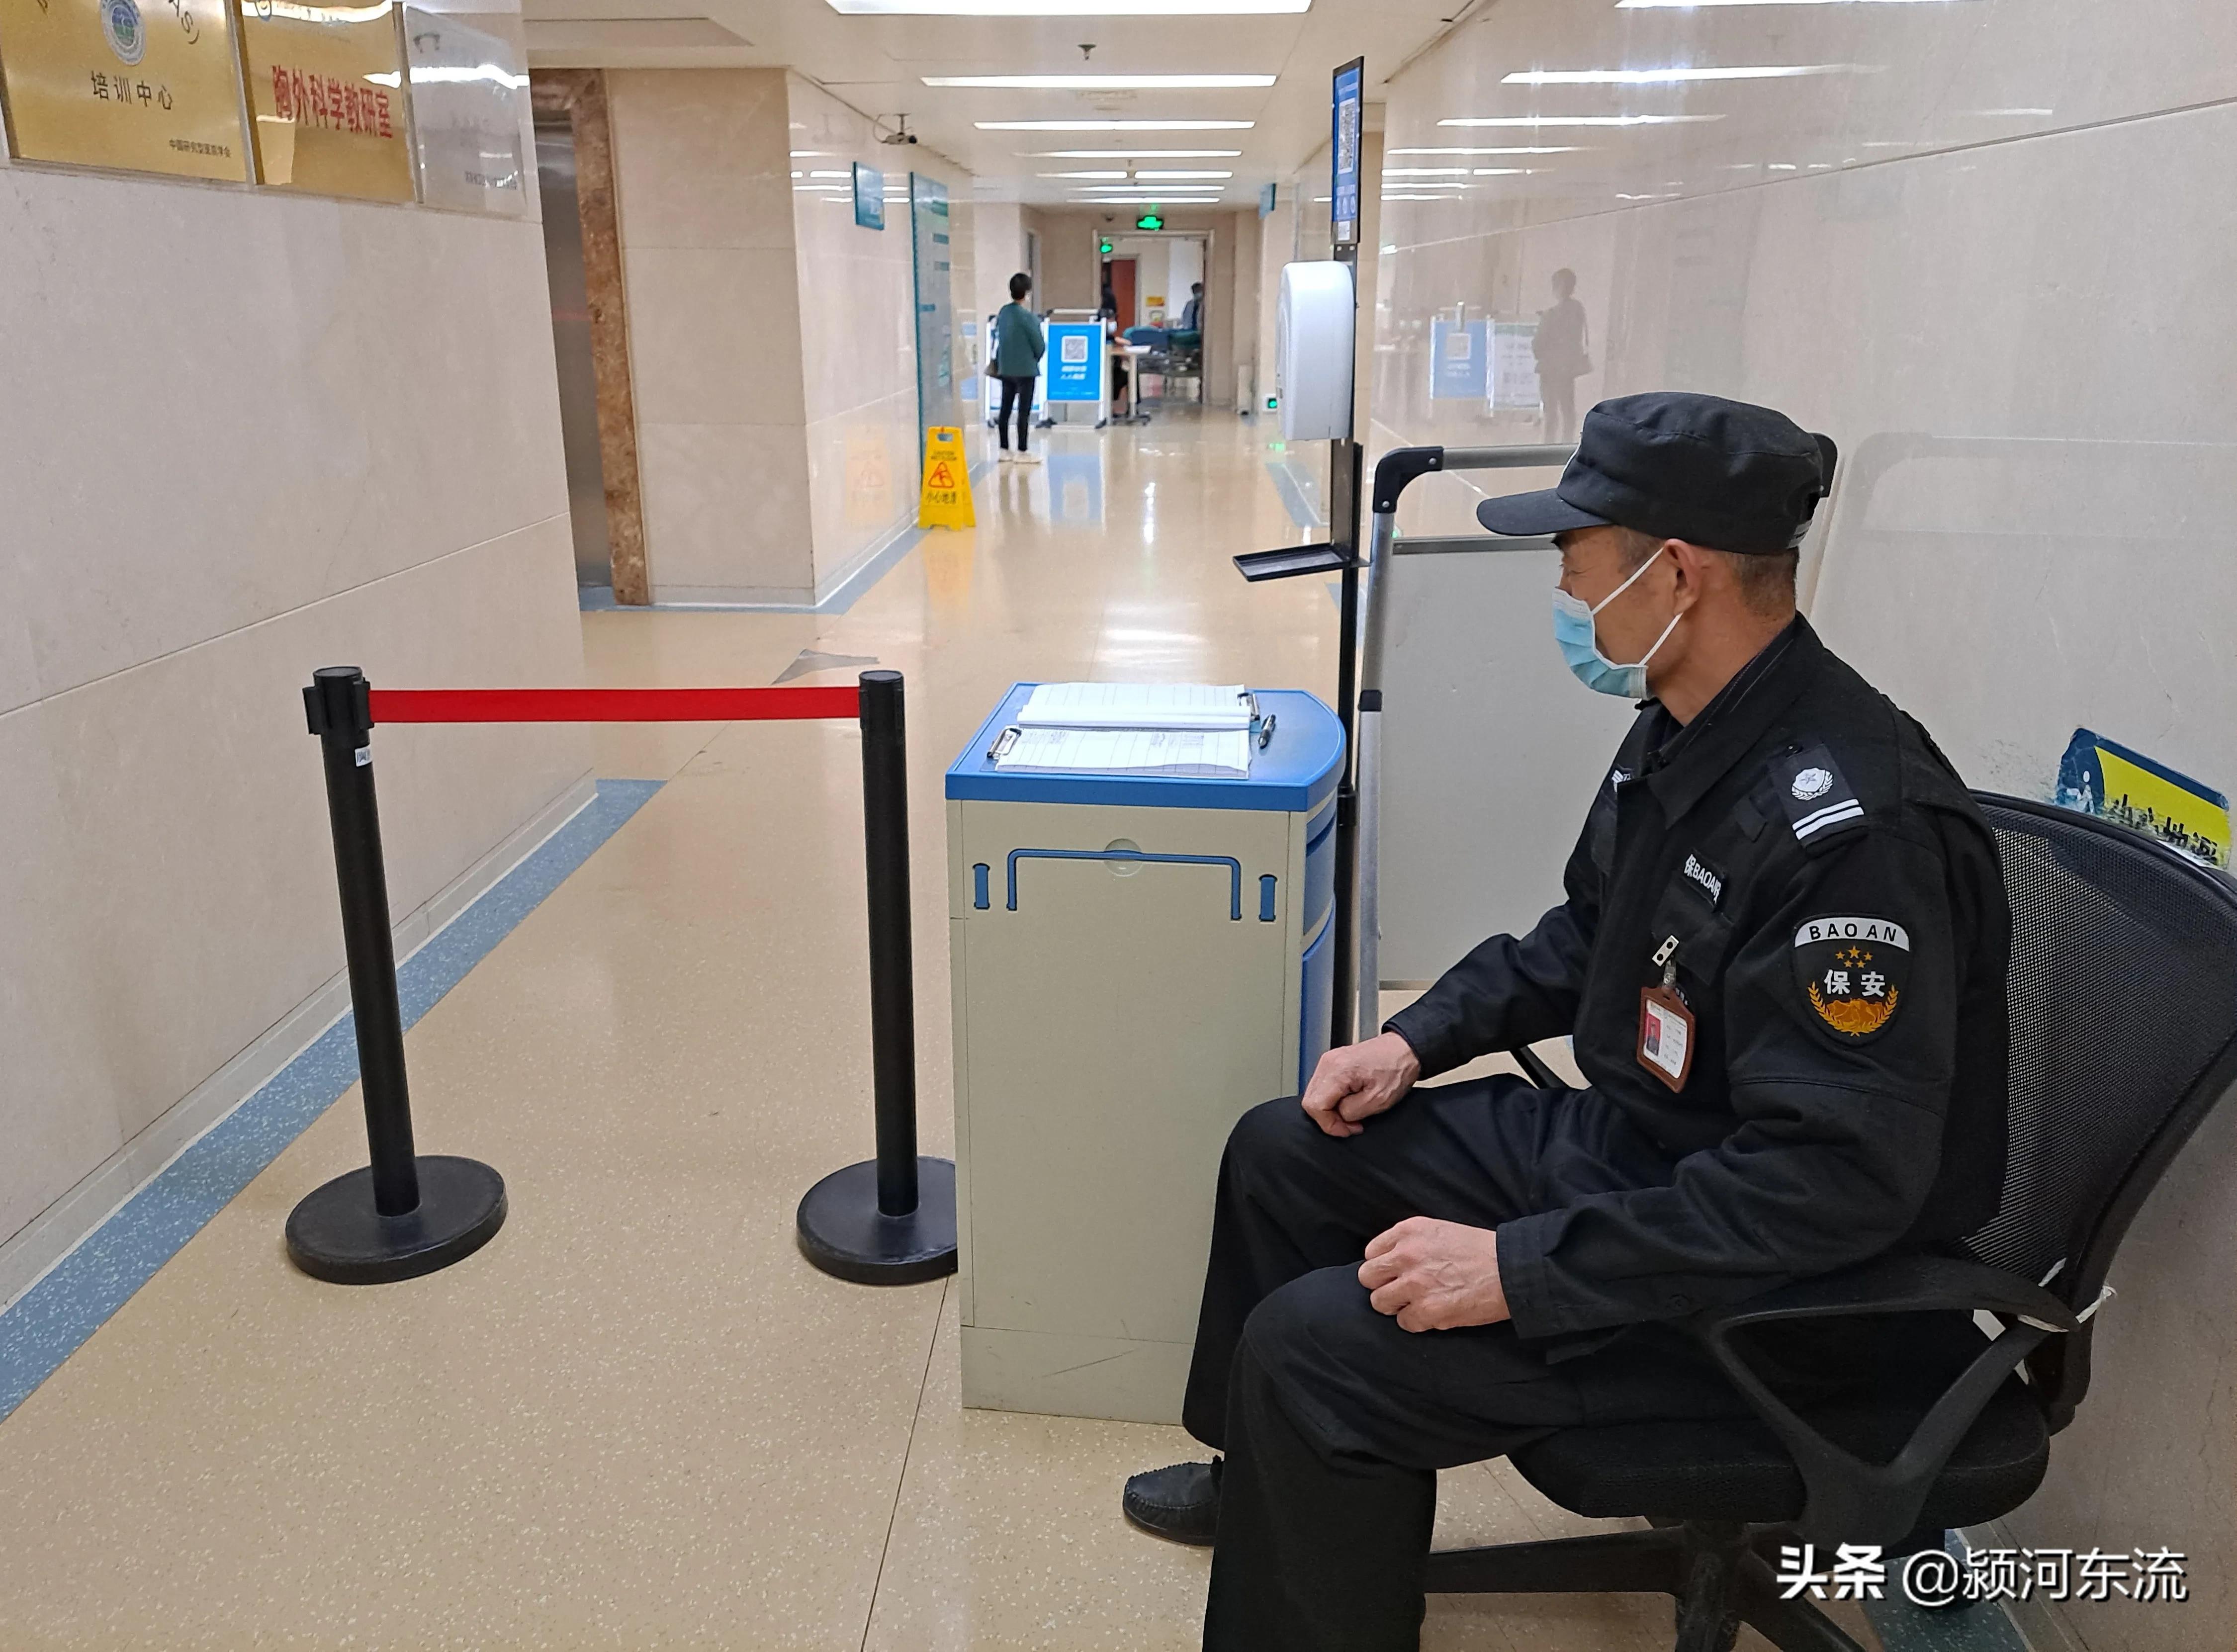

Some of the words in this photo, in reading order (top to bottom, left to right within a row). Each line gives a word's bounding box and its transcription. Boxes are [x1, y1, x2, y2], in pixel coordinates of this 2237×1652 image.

[90, 71, 173, 110] 培训中心
[272, 65, 392, 139] 胸外科学教研室
[1824, 969, 1885, 997] 保安
